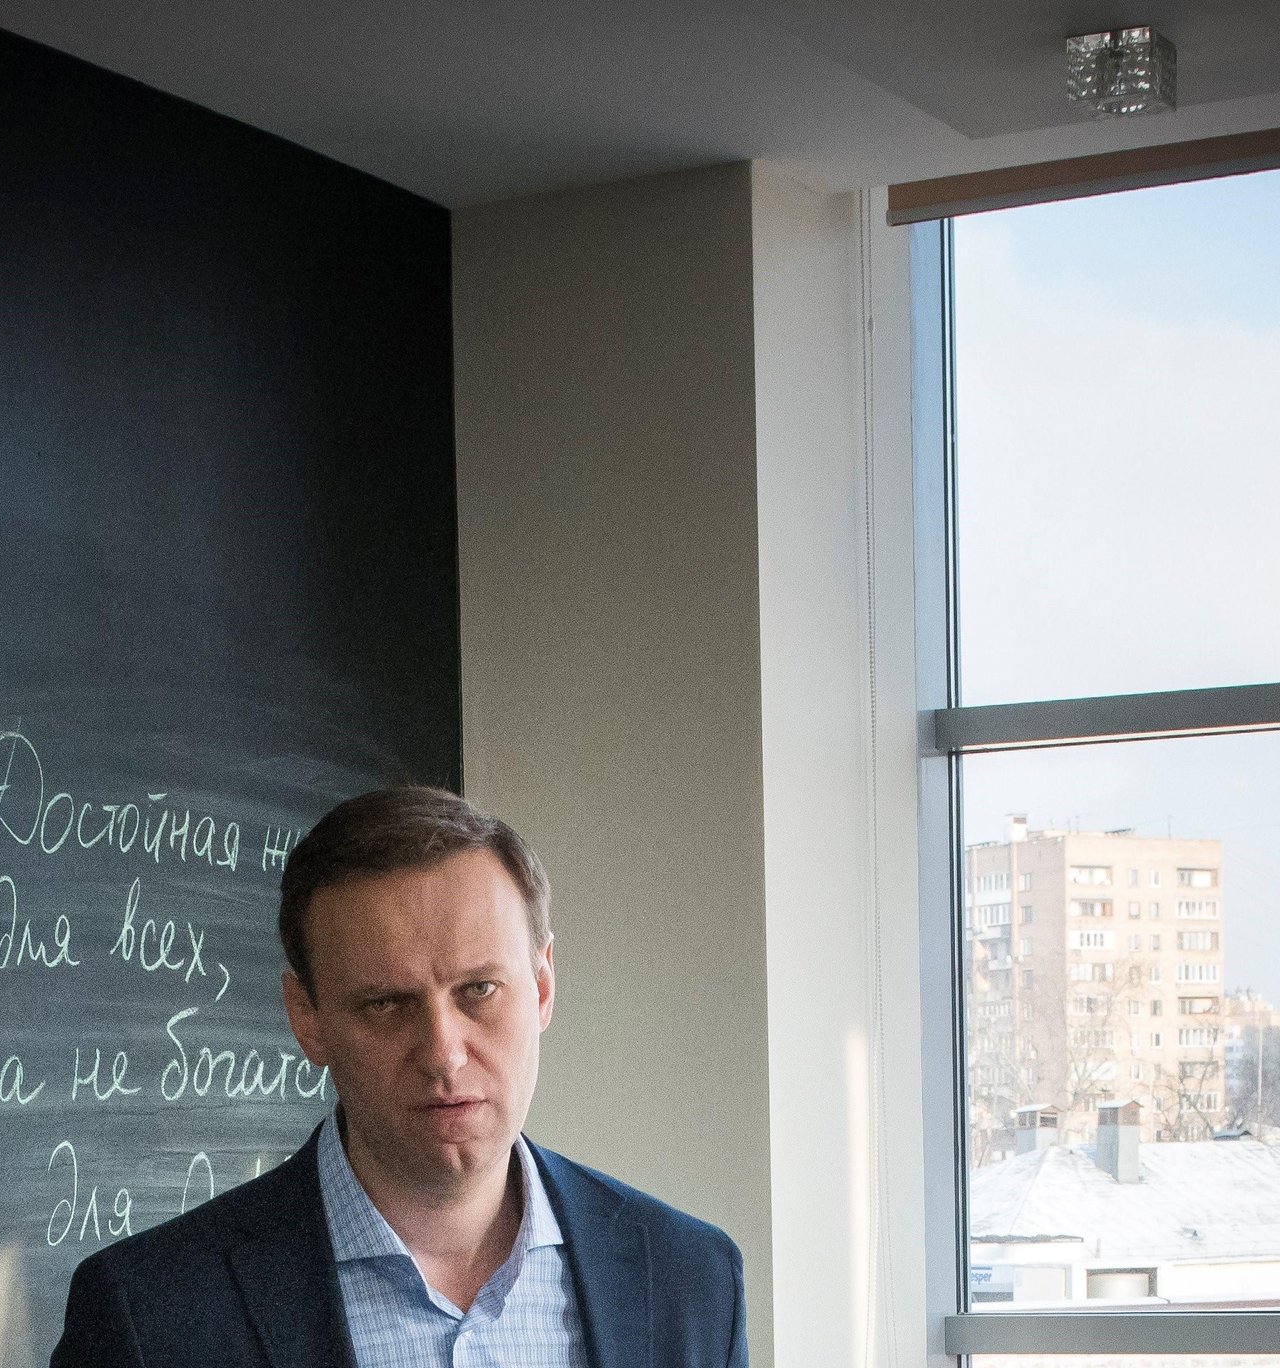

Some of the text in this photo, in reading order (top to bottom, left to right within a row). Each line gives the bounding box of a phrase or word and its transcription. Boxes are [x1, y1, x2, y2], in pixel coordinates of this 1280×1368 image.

[110, 877, 230, 1000] всех,
[72, 1047, 142, 1101] не
[48, 1140, 133, 1246] для
